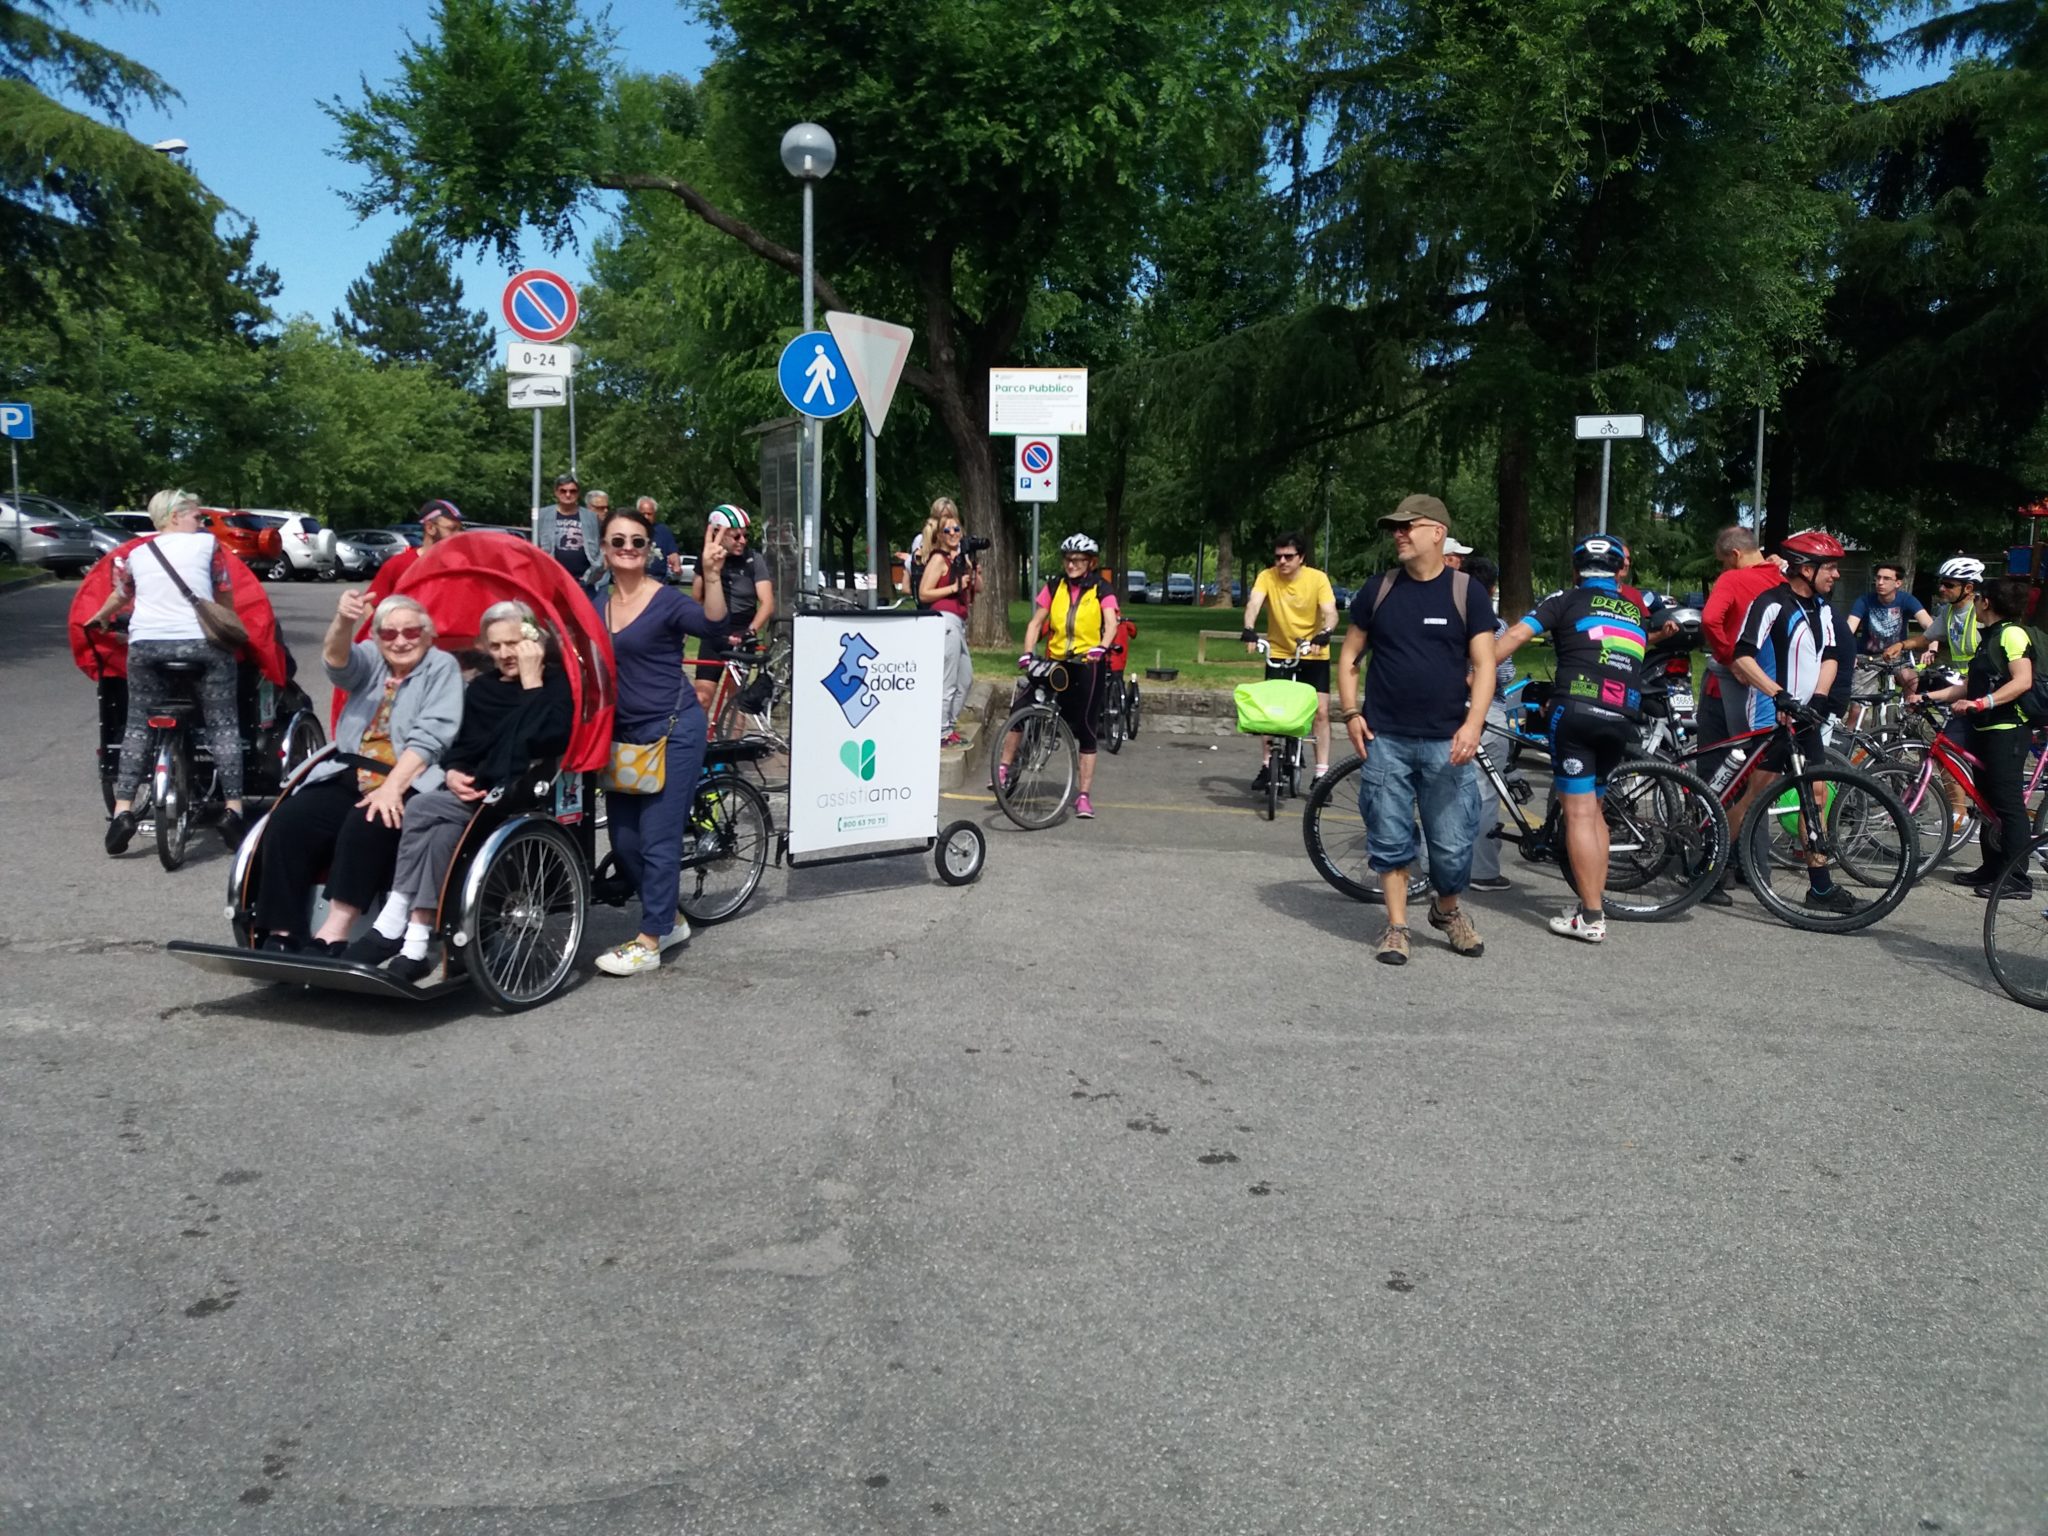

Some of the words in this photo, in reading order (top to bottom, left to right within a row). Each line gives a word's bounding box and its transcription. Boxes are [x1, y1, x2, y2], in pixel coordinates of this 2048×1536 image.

[523, 351, 556, 366] 0-24
[995, 384, 1026, 393] Parco
[1029, 383, 1074, 393] Pubblico
[0, 407, 24, 435] P
[1591, 595, 1641, 626] DEKA
[870, 660, 917, 674] società
[870, 674, 915, 691] dolce
[816, 787, 912, 809] assistiamo
